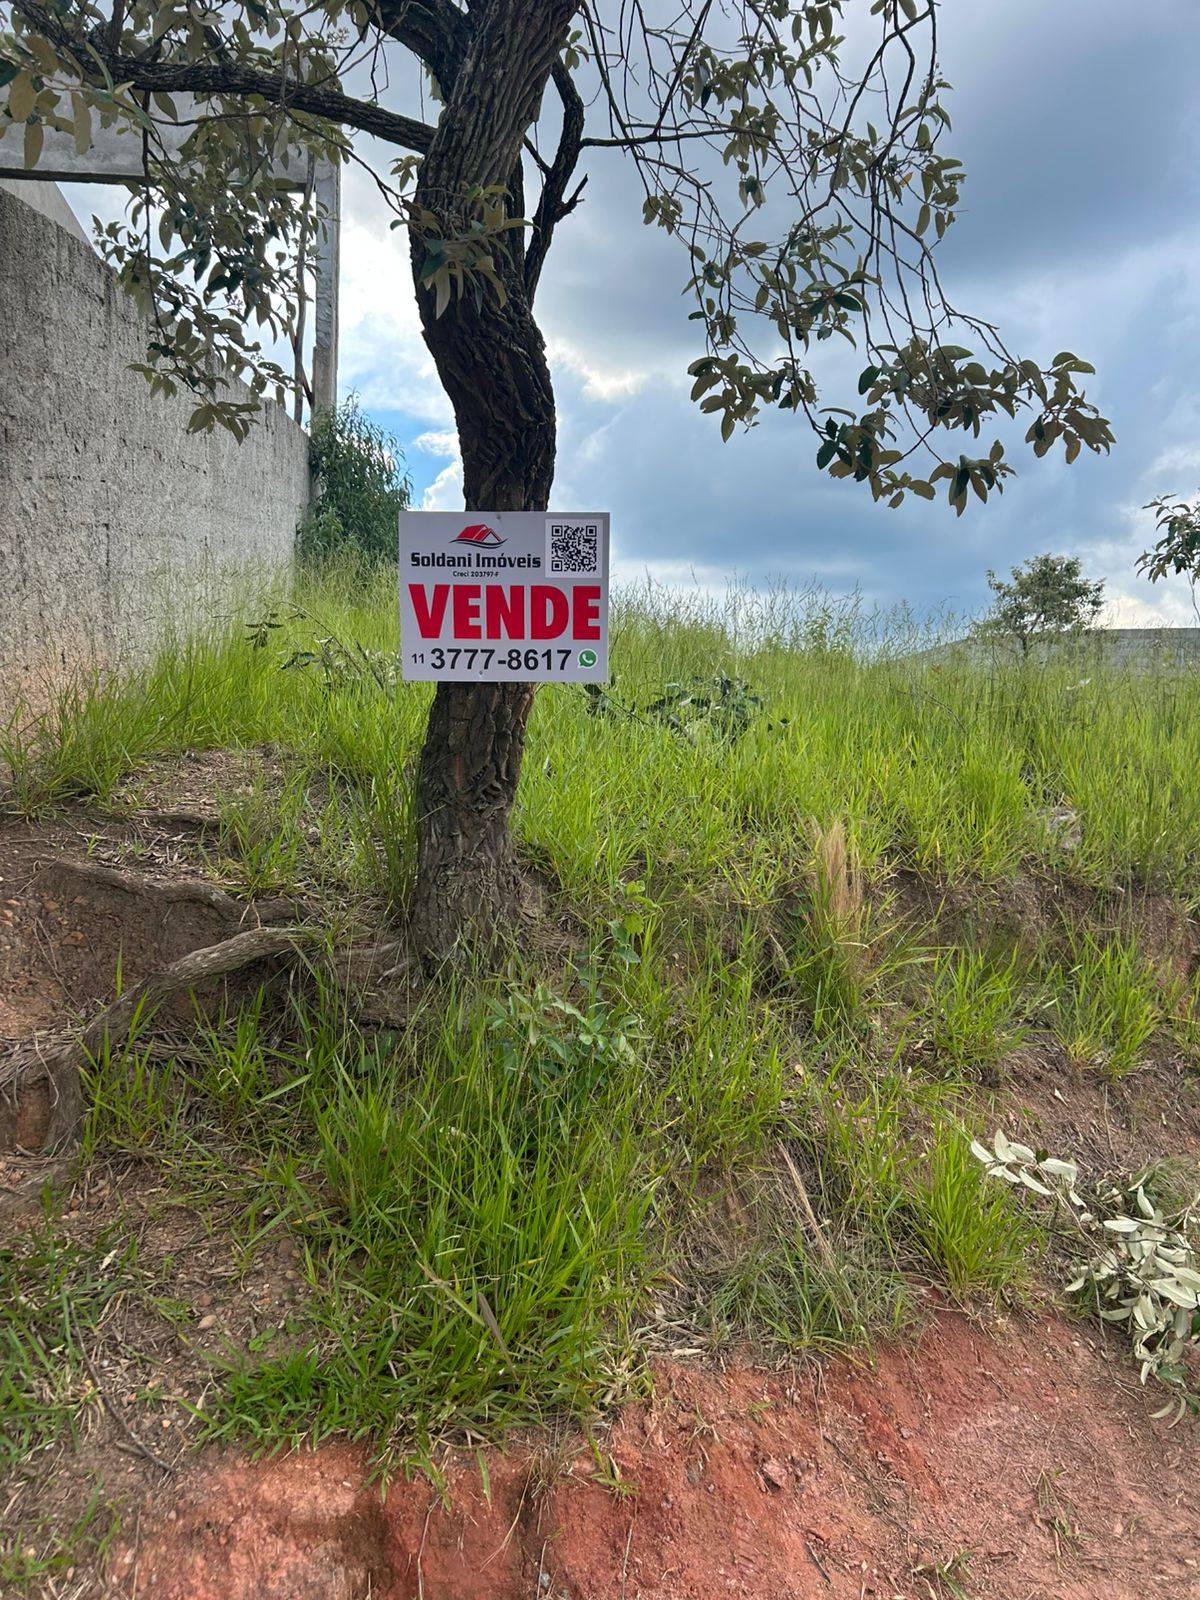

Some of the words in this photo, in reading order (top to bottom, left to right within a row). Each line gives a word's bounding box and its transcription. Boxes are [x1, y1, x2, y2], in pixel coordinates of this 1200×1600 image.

[411, 552, 472, 568] Soldani
[476, 552, 541, 568] Imóveis
[408, 584, 601, 640] VENDE
[411, 653, 424, 664] 11
[430, 648, 572, 670] 3777-8617
